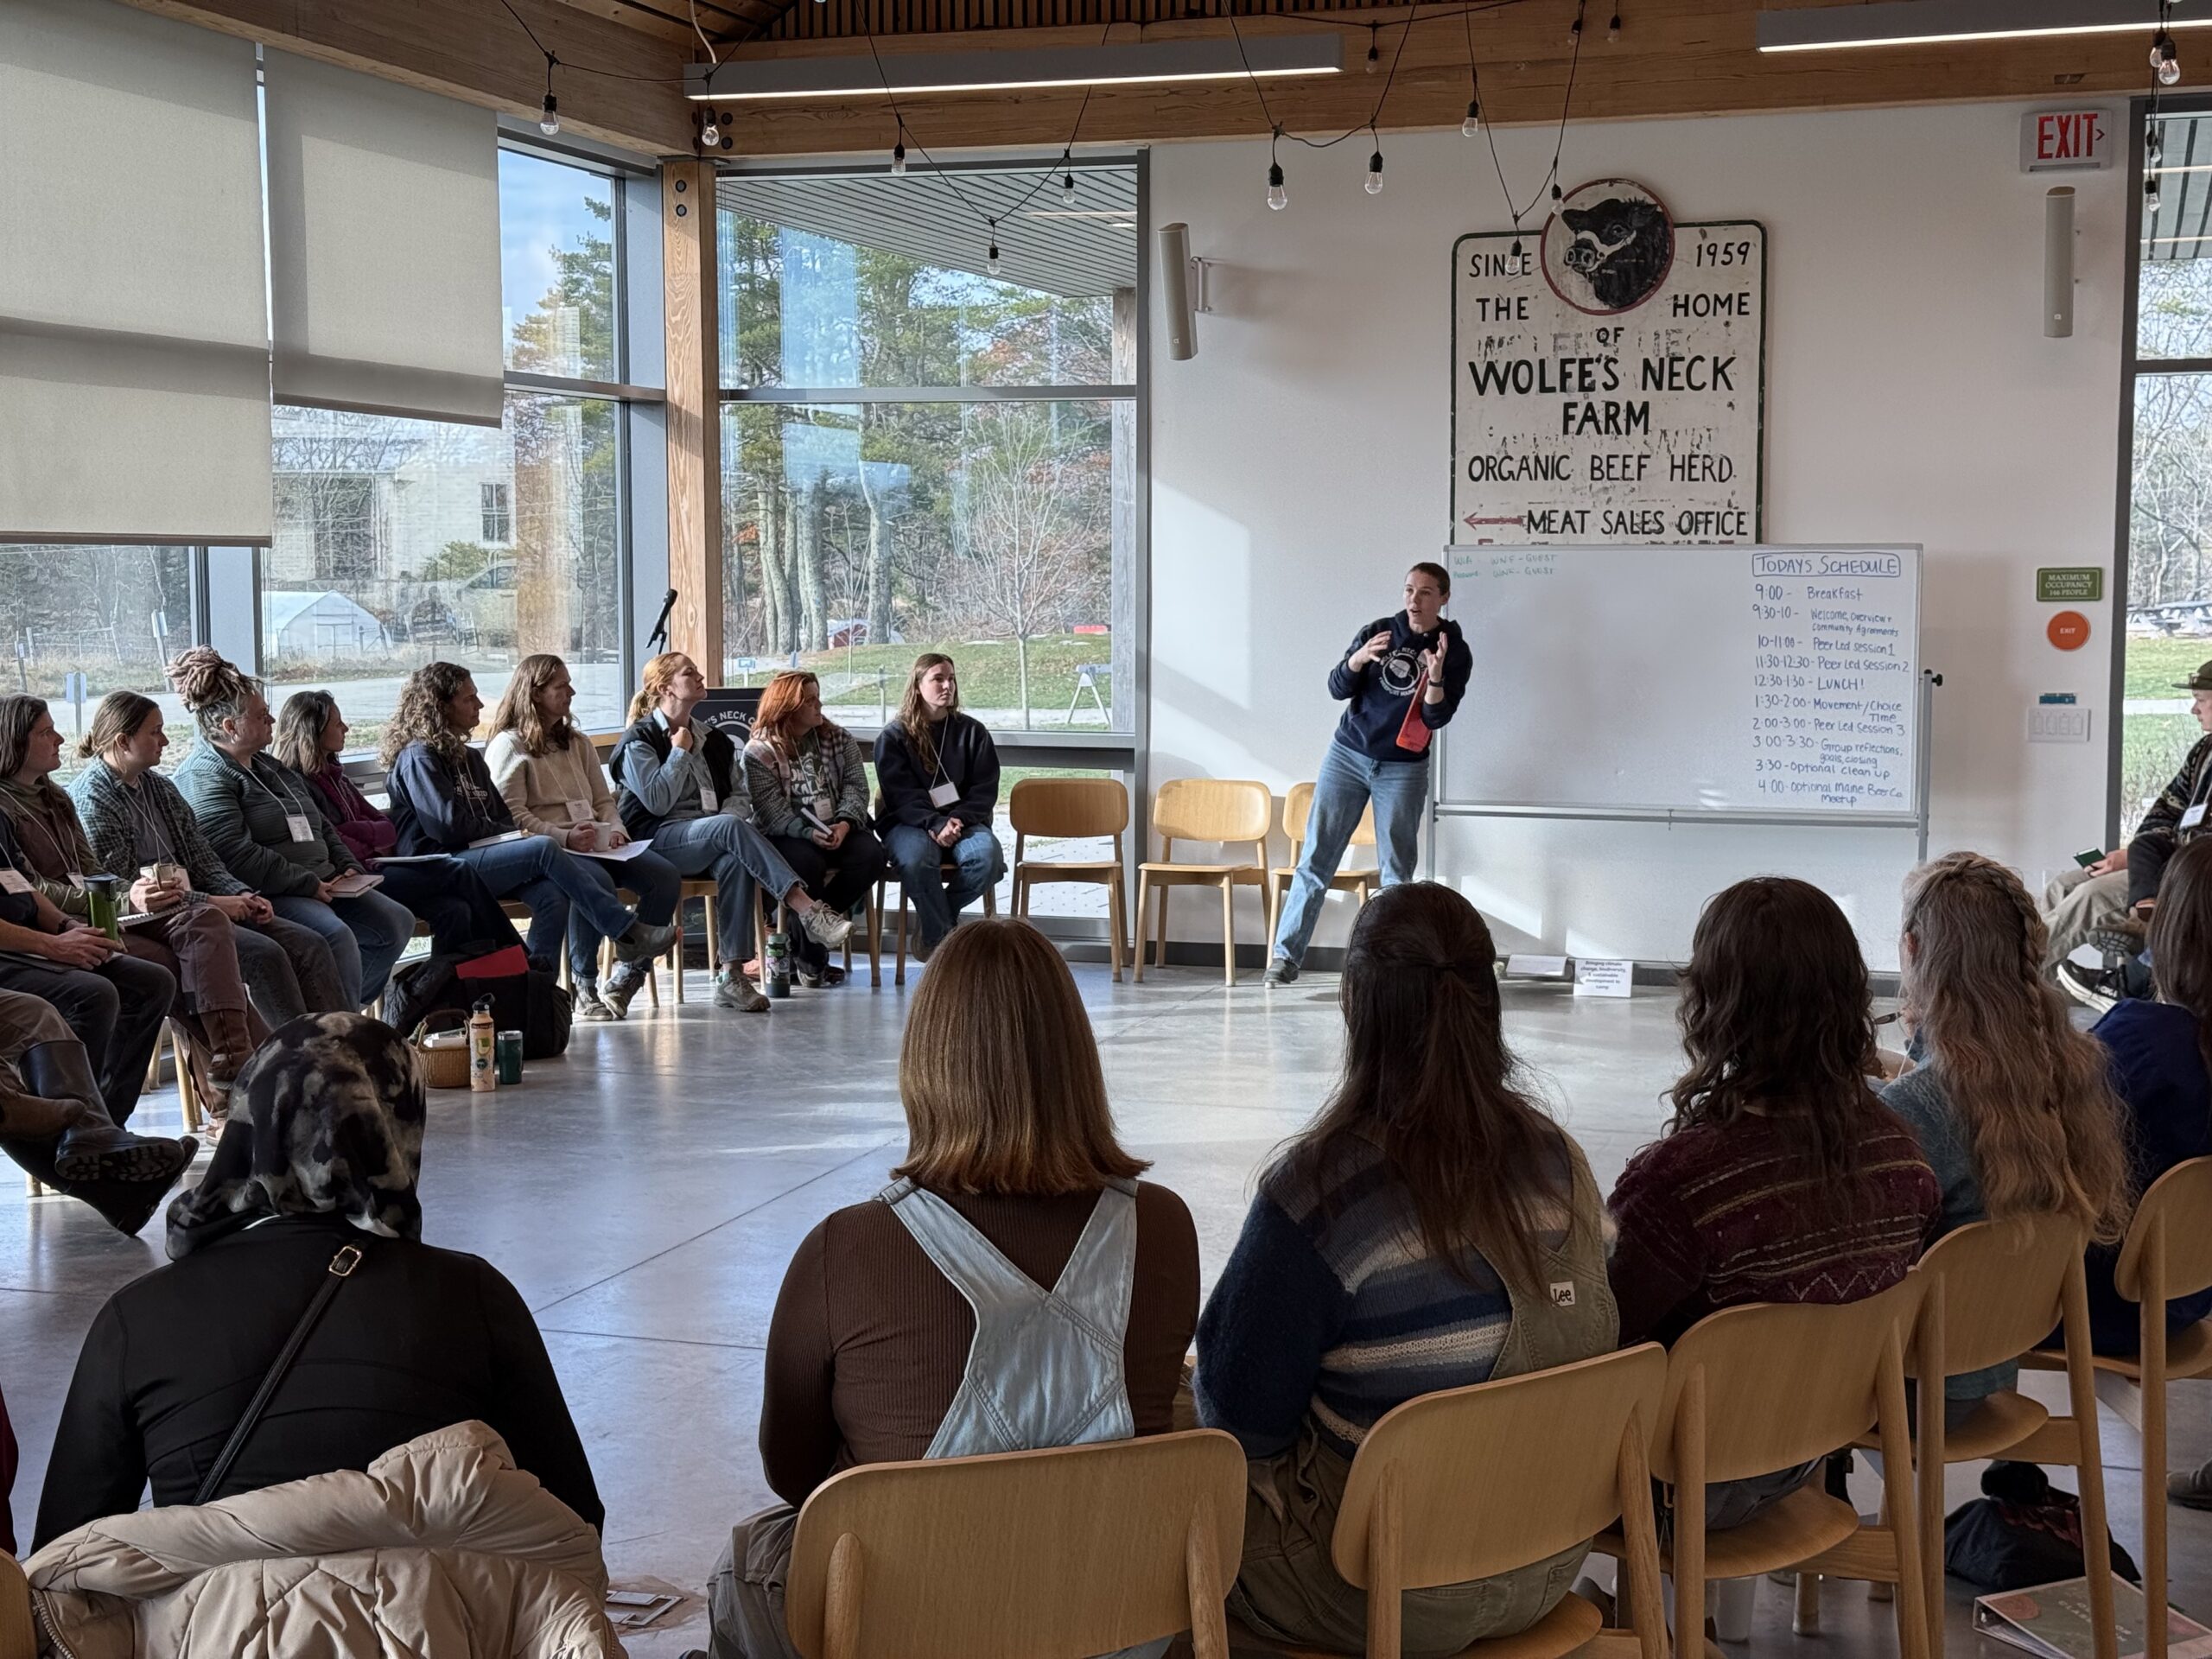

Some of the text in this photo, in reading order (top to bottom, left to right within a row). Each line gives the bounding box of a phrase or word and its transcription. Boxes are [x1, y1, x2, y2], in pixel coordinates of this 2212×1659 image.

[2037, 113, 2098, 159] EXIT
[1696, 242, 1751, 267] 1959
[1476, 292, 1751, 321] THE HOME
[1597, 327, 1624, 344] OF
[1469, 356, 1737, 396] WOLFE'S NECK
[1562, 401, 1649, 435] FARM
[1468, 455, 1572, 482] ORGANIC
[1590, 454, 1651, 481] BEEF
[1527, 510, 1748, 536] MEAT SALES OFFICE
[1755, 583, 1783, 600] 9:00
[1807, 586, 1863, 601] Breakfast
[1813, 637, 1834, 651] Peer
[1835, 640, 1850, 651] Led
[1888, 643, 1896, 657] 1
[1818, 656, 1841, 670] Peer
[1845, 658, 1860, 670] Led
[1902, 660, 1910, 672] 2
[1817, 677, 1866, 690] LUNCH!
[720, 710, 747, 721] NECK
[1814, 718, 1834, 731] Peer
[1838, 721, 1853, 732] Led
[1896, 724, 1905, 736] 3
[1821, 738, 1853, 753] Group
[1874, 770, 1891, 780] up
[1554, 1288, 1573, 1302] Lee
